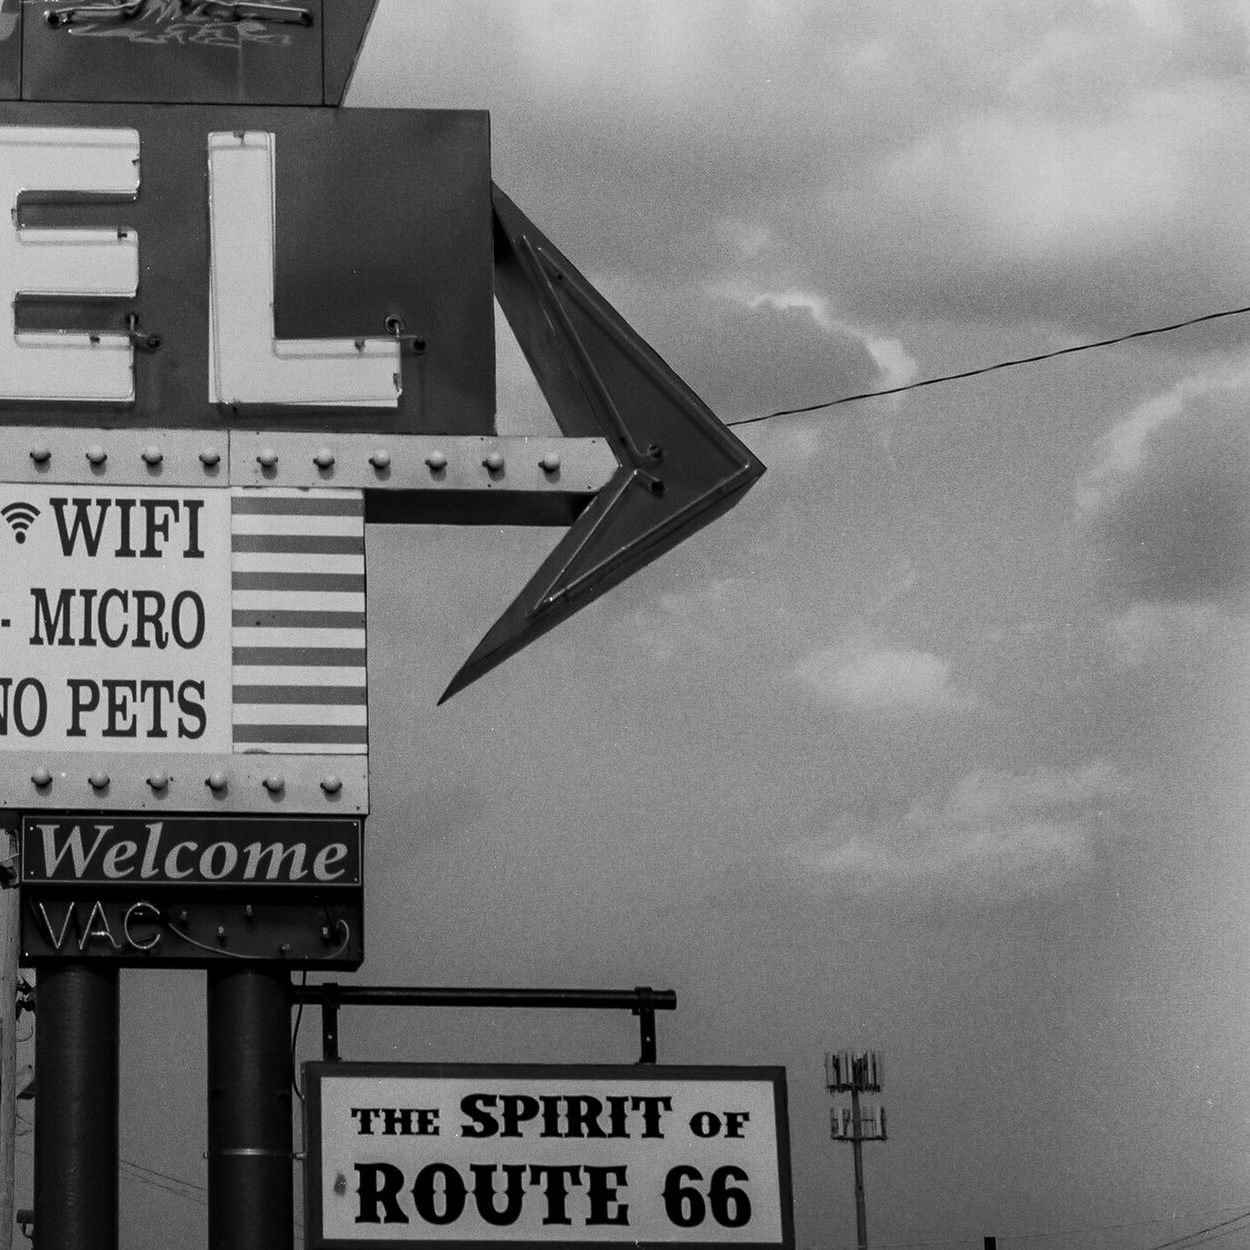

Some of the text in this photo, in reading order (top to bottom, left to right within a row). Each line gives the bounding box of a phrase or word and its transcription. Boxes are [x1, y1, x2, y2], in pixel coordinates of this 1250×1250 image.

[49, 498, 205, 559] WIFI
[30, 588, 205, 649] MICRO
[66, 678, 207, 740] PETS
[36, 822, 348, 881] Welcome
[351, 1093, 750, 1139] THE SPIRIT OF
[354, 1162, 752, 1228] ROUTE 66
